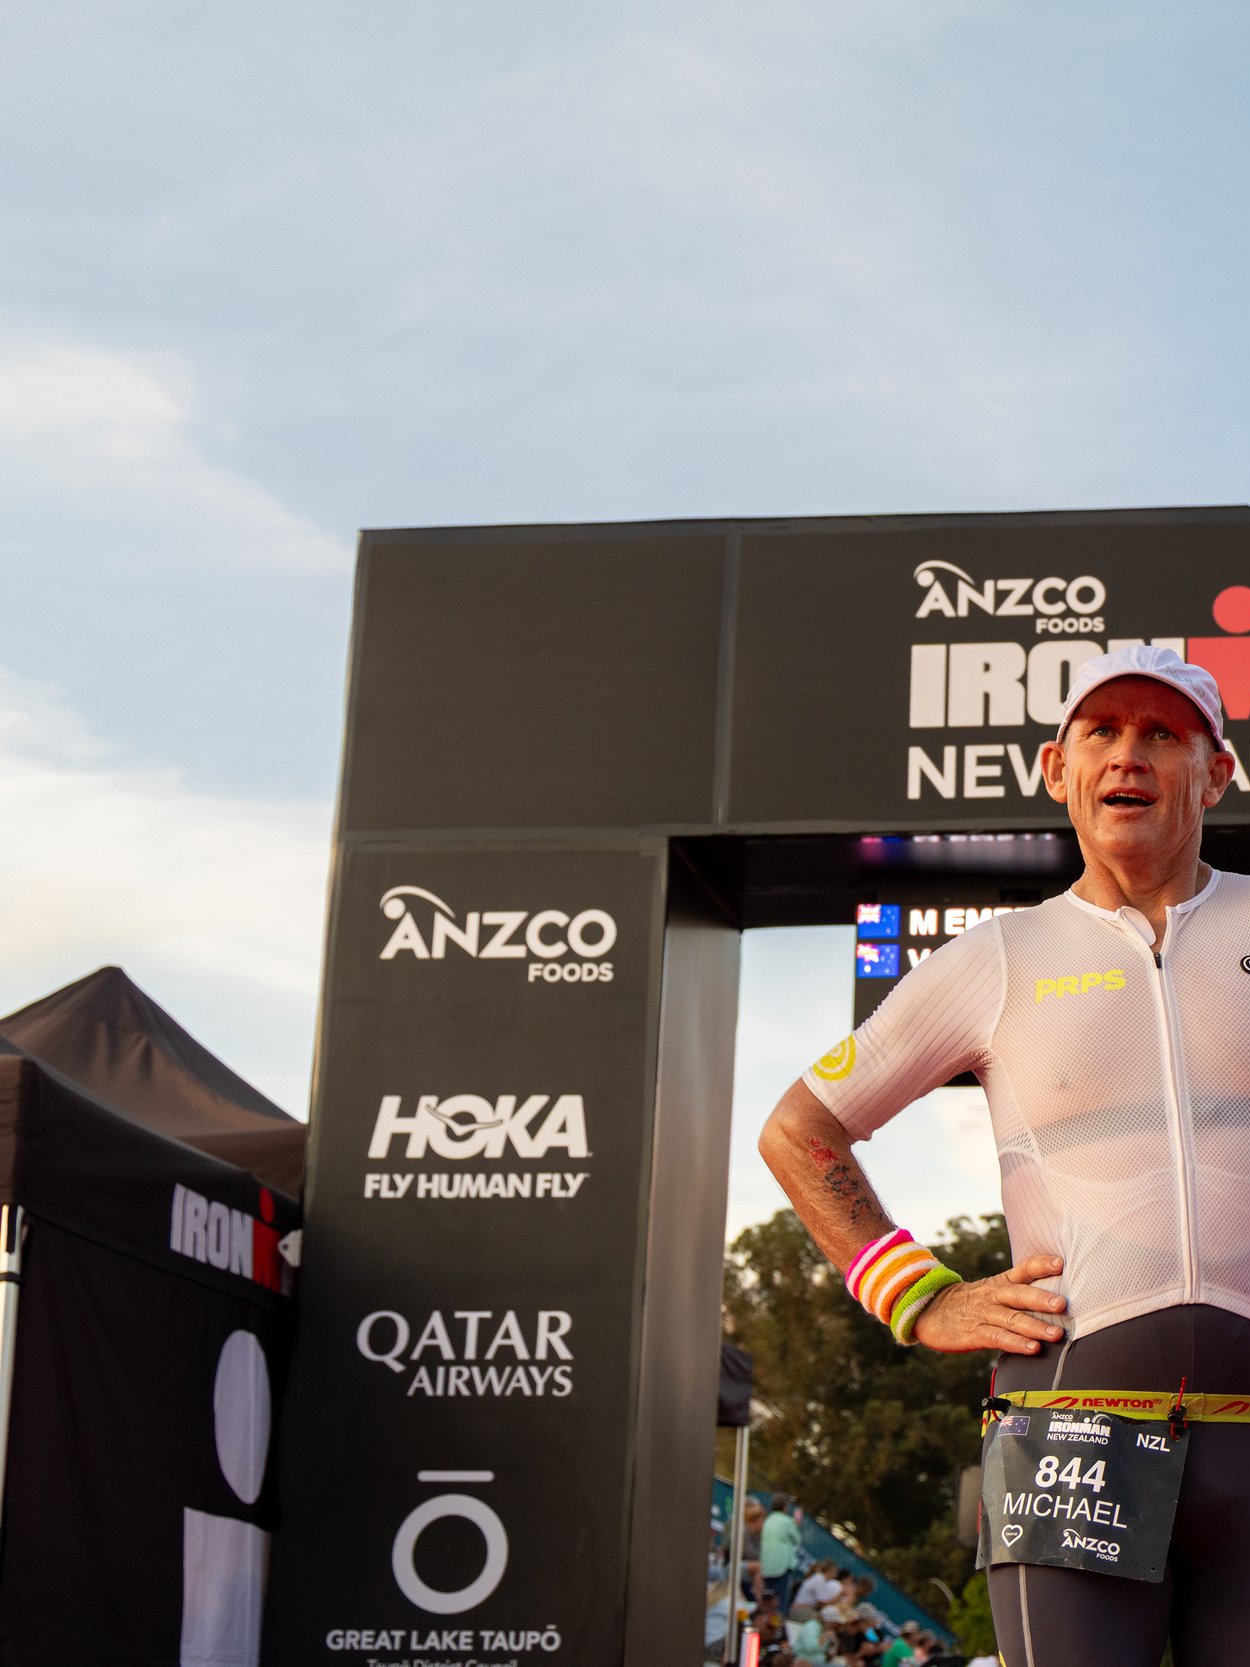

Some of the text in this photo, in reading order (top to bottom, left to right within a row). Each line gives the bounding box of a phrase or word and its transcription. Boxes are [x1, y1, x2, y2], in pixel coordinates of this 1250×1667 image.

[914, 566, 1106, 618] ANZCO
[1036, 616, 1105, 634] FOODS
[379, 897, 617, 959] ANZCO
[909, 907, 939, 937] M
[527, 962, 614, 982] FOODS
[1035, 969, 1127, 1003] PRPS
[368, 1094, 588, 1159] HOKA
[364, 1172, 585, 1198] FLY HUMAN FLY
[356, 1310, 574, 1373] QATAR
[406, 1365, 574, 1397] AIRWAYS
[1046, 1433, 1109, 1445] NEW ZEALAND
[1048, 1421, 1111, 1437] IRONMAN
[1136, 1433, 1170, 1452] NZL
[1035, 1455, 1107, 1493] 844
[1003, 1492, 1128, 1529] MICHAEL
[1061, 1532, 1121, 1556] ANZCO
[1096, 1553, 1119, 1562] FOODS
[326, 1624, 561, 1651] GREAT LAKE TAUPŌ
